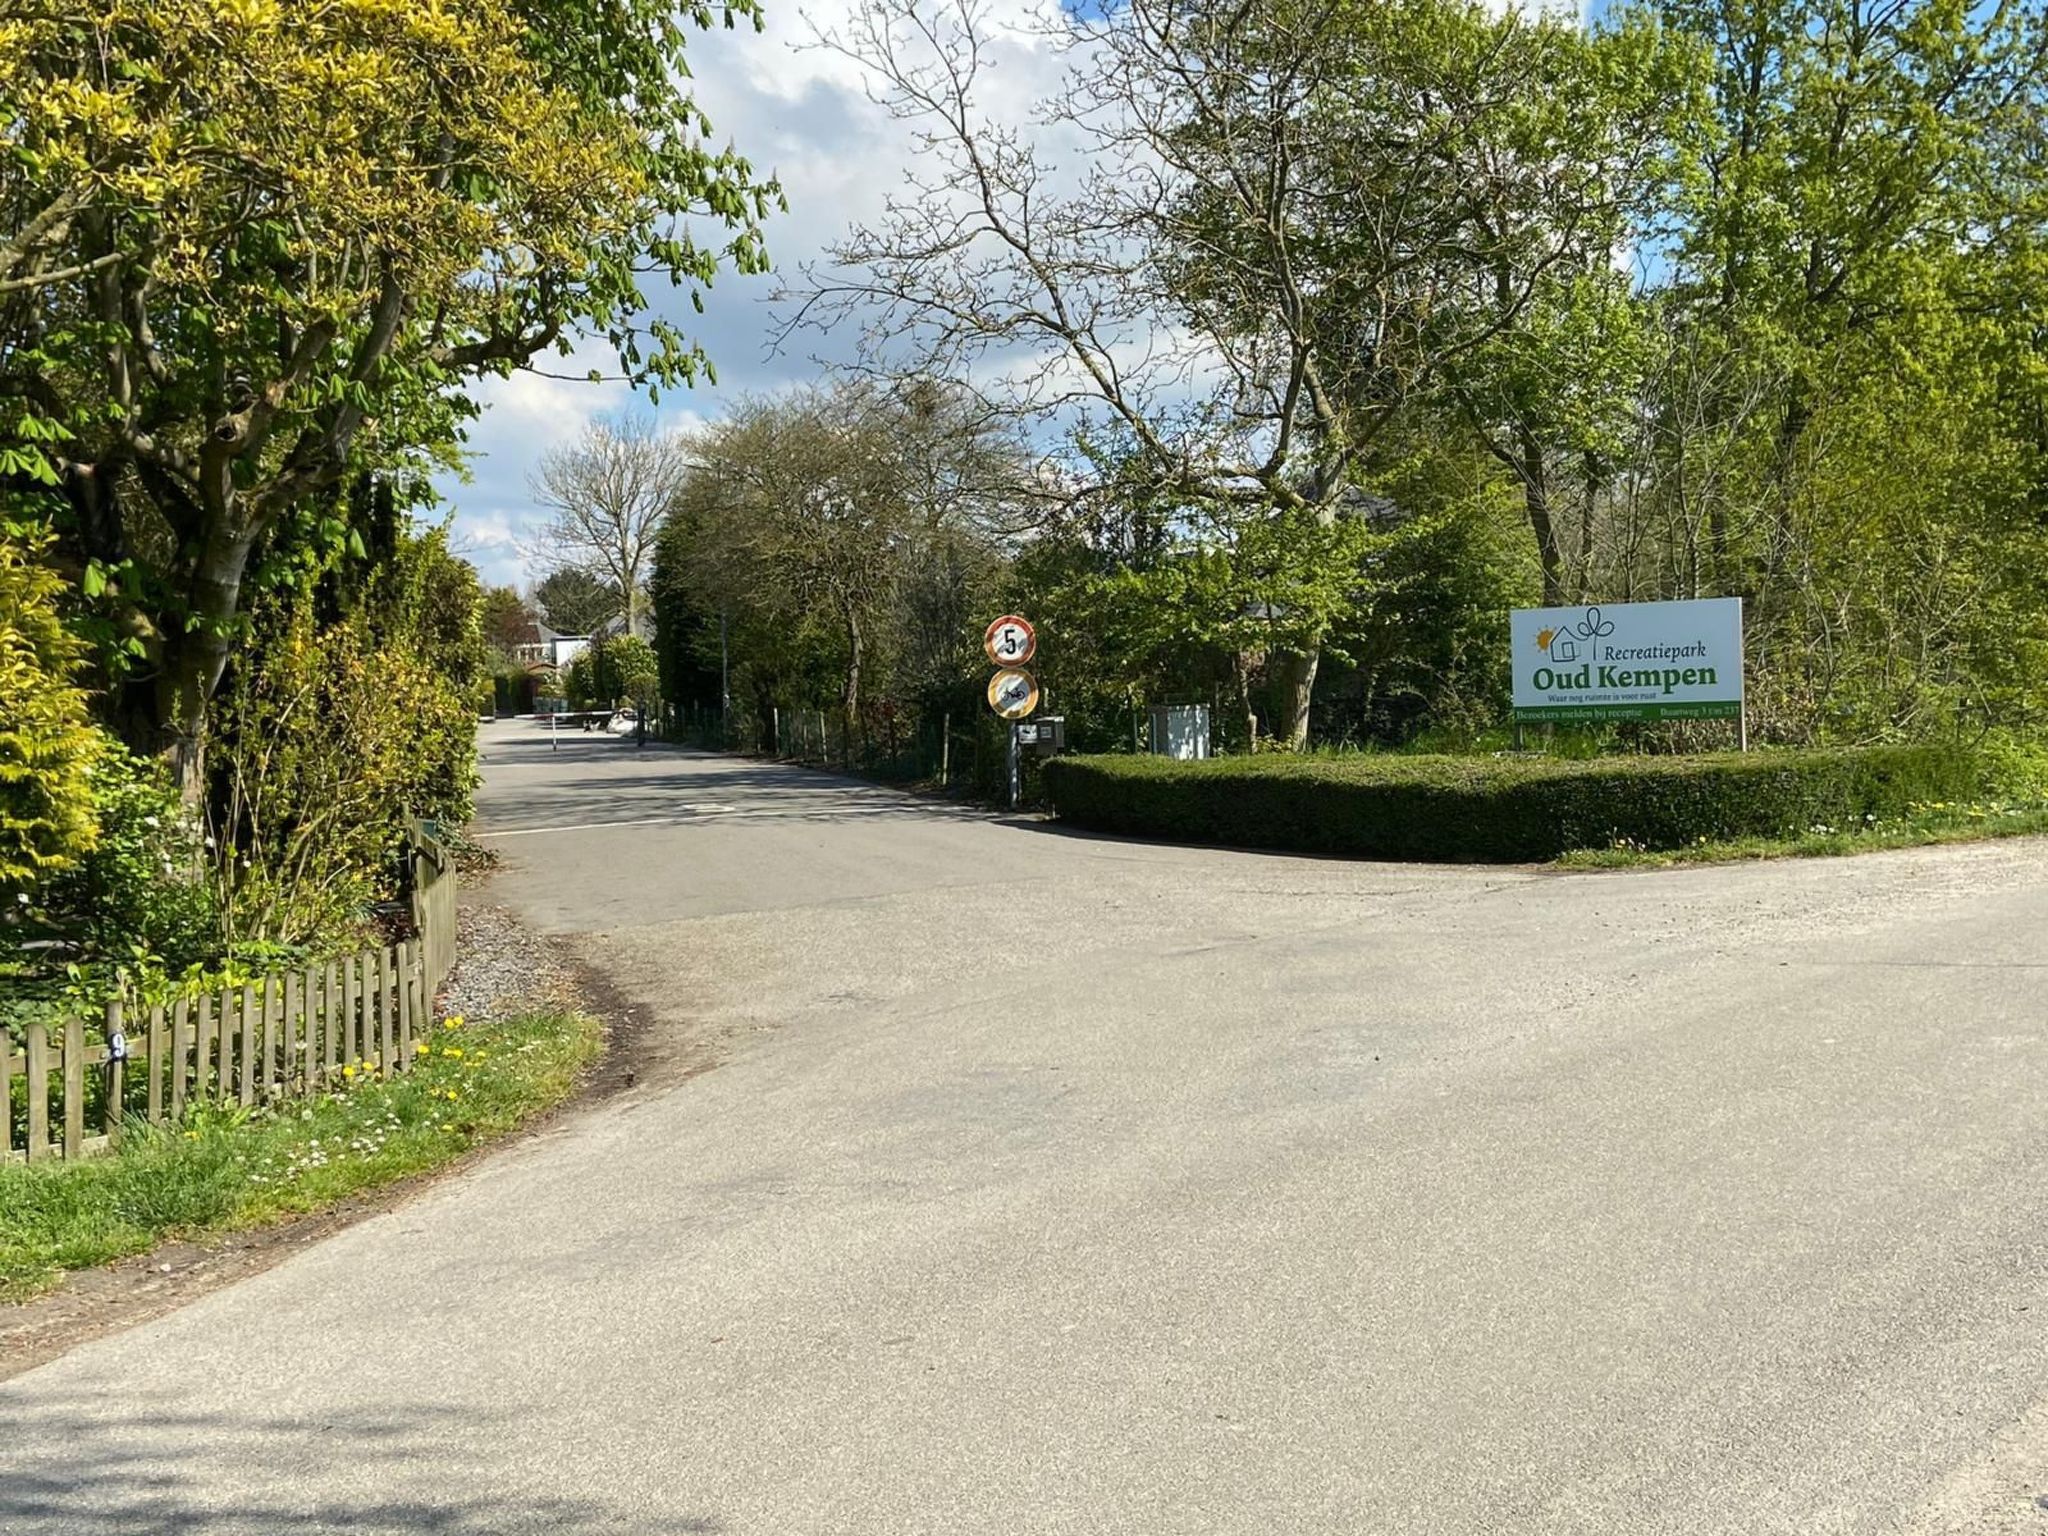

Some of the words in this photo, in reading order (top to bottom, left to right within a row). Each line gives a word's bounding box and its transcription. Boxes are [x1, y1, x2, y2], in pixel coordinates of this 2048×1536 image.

[1004, 629, 1016, 655] 5
[1605, 641, 1706, 663] Recreatiepark
[1533, 664, 1591, 691] Oud
[1597, 665, 1718, 695] Kempen
[1569, 695, 1583, 703] nog
[1561, 709, 1592, 718] melden
[1594, 708, 1606, 720] bij
[112, 1033, 125, 1057] 9
